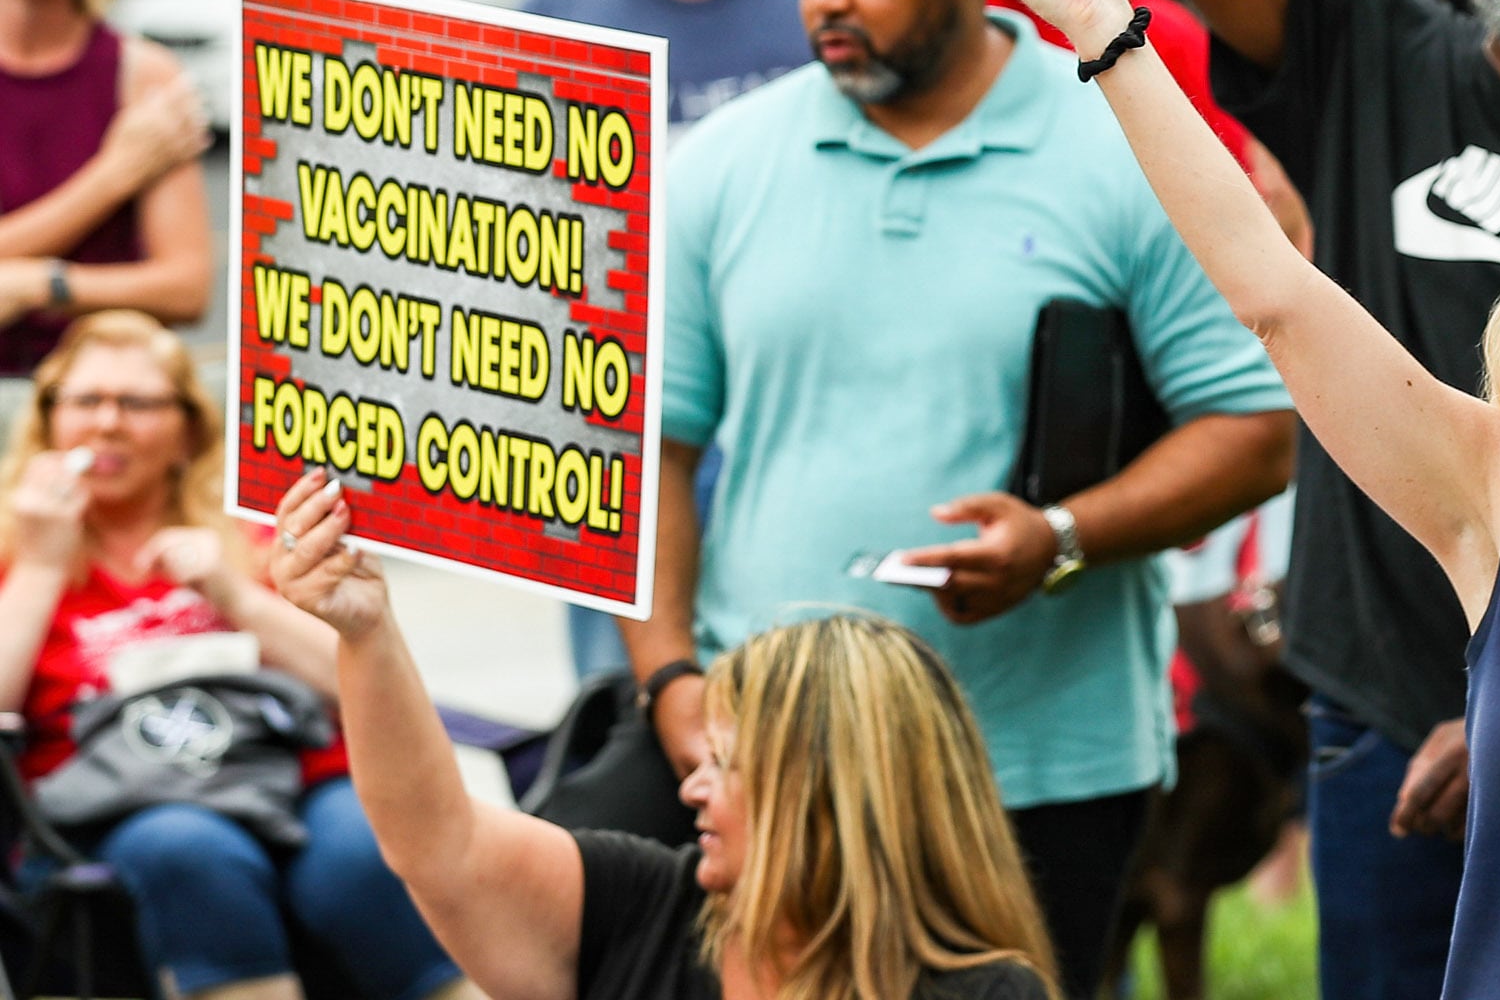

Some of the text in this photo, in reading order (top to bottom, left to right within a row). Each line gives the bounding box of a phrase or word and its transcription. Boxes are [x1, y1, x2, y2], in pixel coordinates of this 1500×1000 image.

[253, 45, 634, 188] WE DON'T NEED NO
[298, 165, 583, 293] VACCINATION!
[254, 266, 630, 417] WE DON'T NEED NO
[253, 376, 624, 533] FORCED CONTROL!
